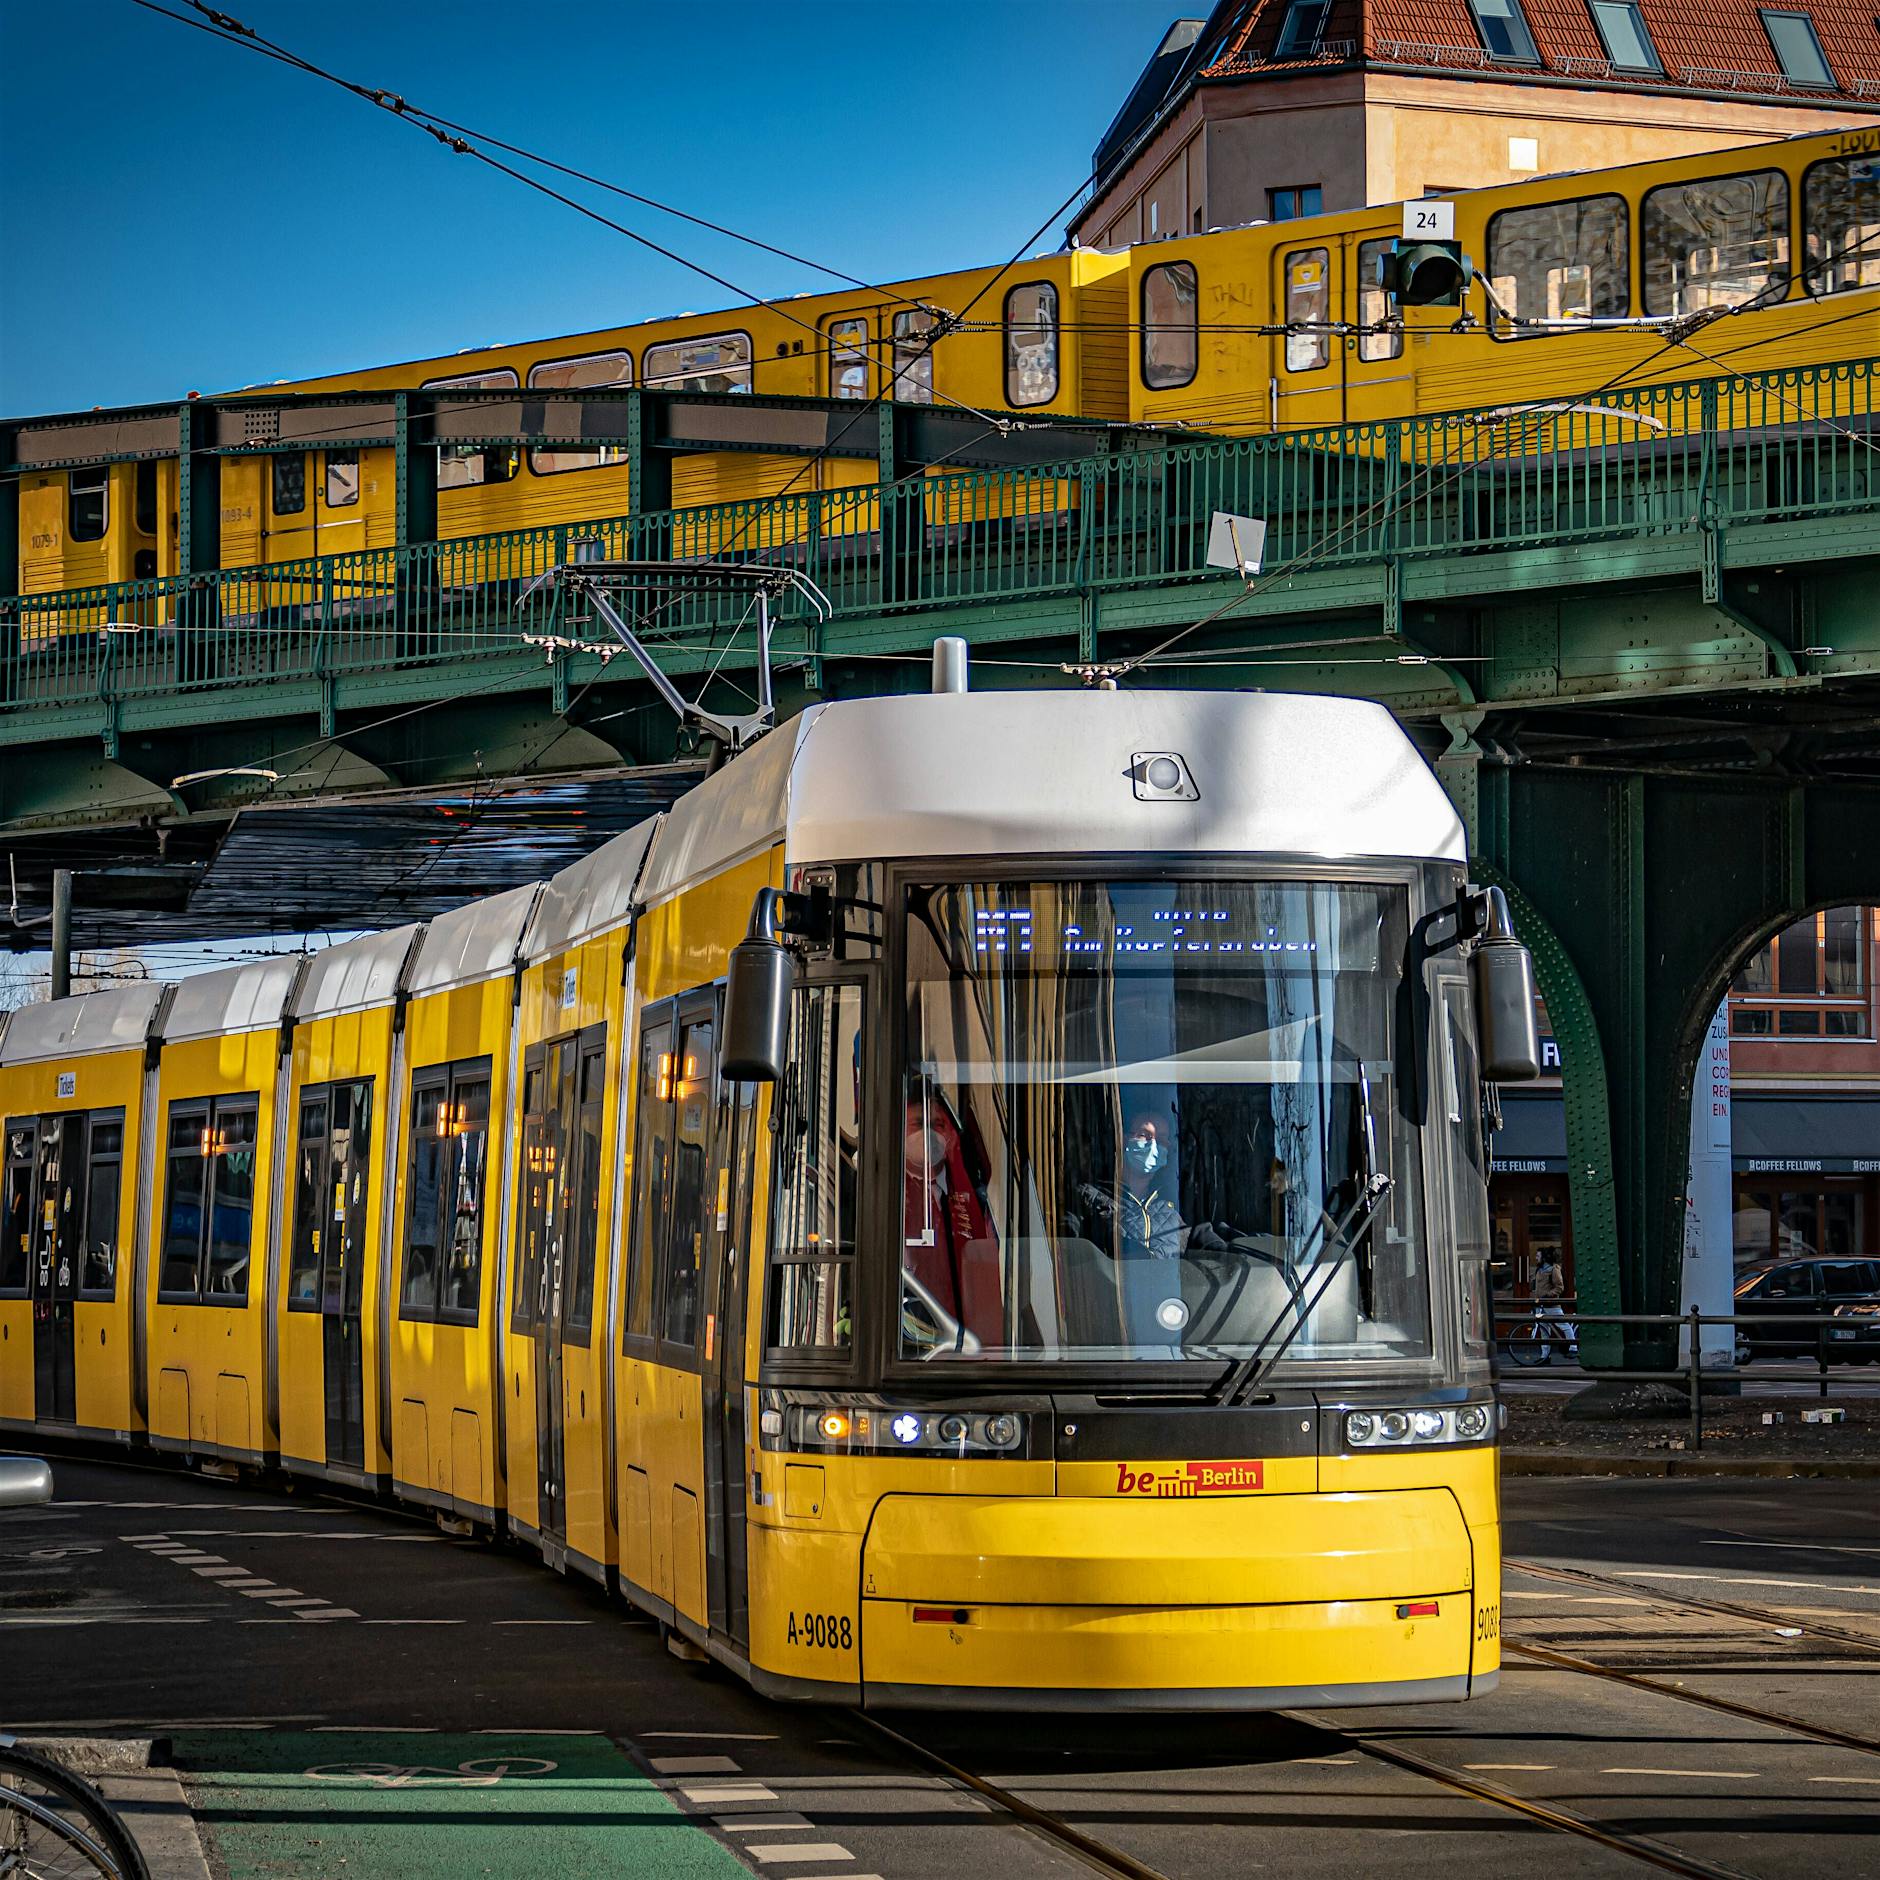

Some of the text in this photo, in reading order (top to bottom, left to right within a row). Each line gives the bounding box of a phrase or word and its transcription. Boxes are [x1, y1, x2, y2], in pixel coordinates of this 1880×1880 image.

[1416, 212, 1437, 228] 24
[32, 534, 58, 549] 1079-1
[1509, 1160, 1546, 1172] FELLOWS
[1755, 1160, 1822, 1171] COFFEE FELLOWS
[1117, 1463, 1257, 1493] be Berlin
[787, 1611, 853, 1650] A-9088
